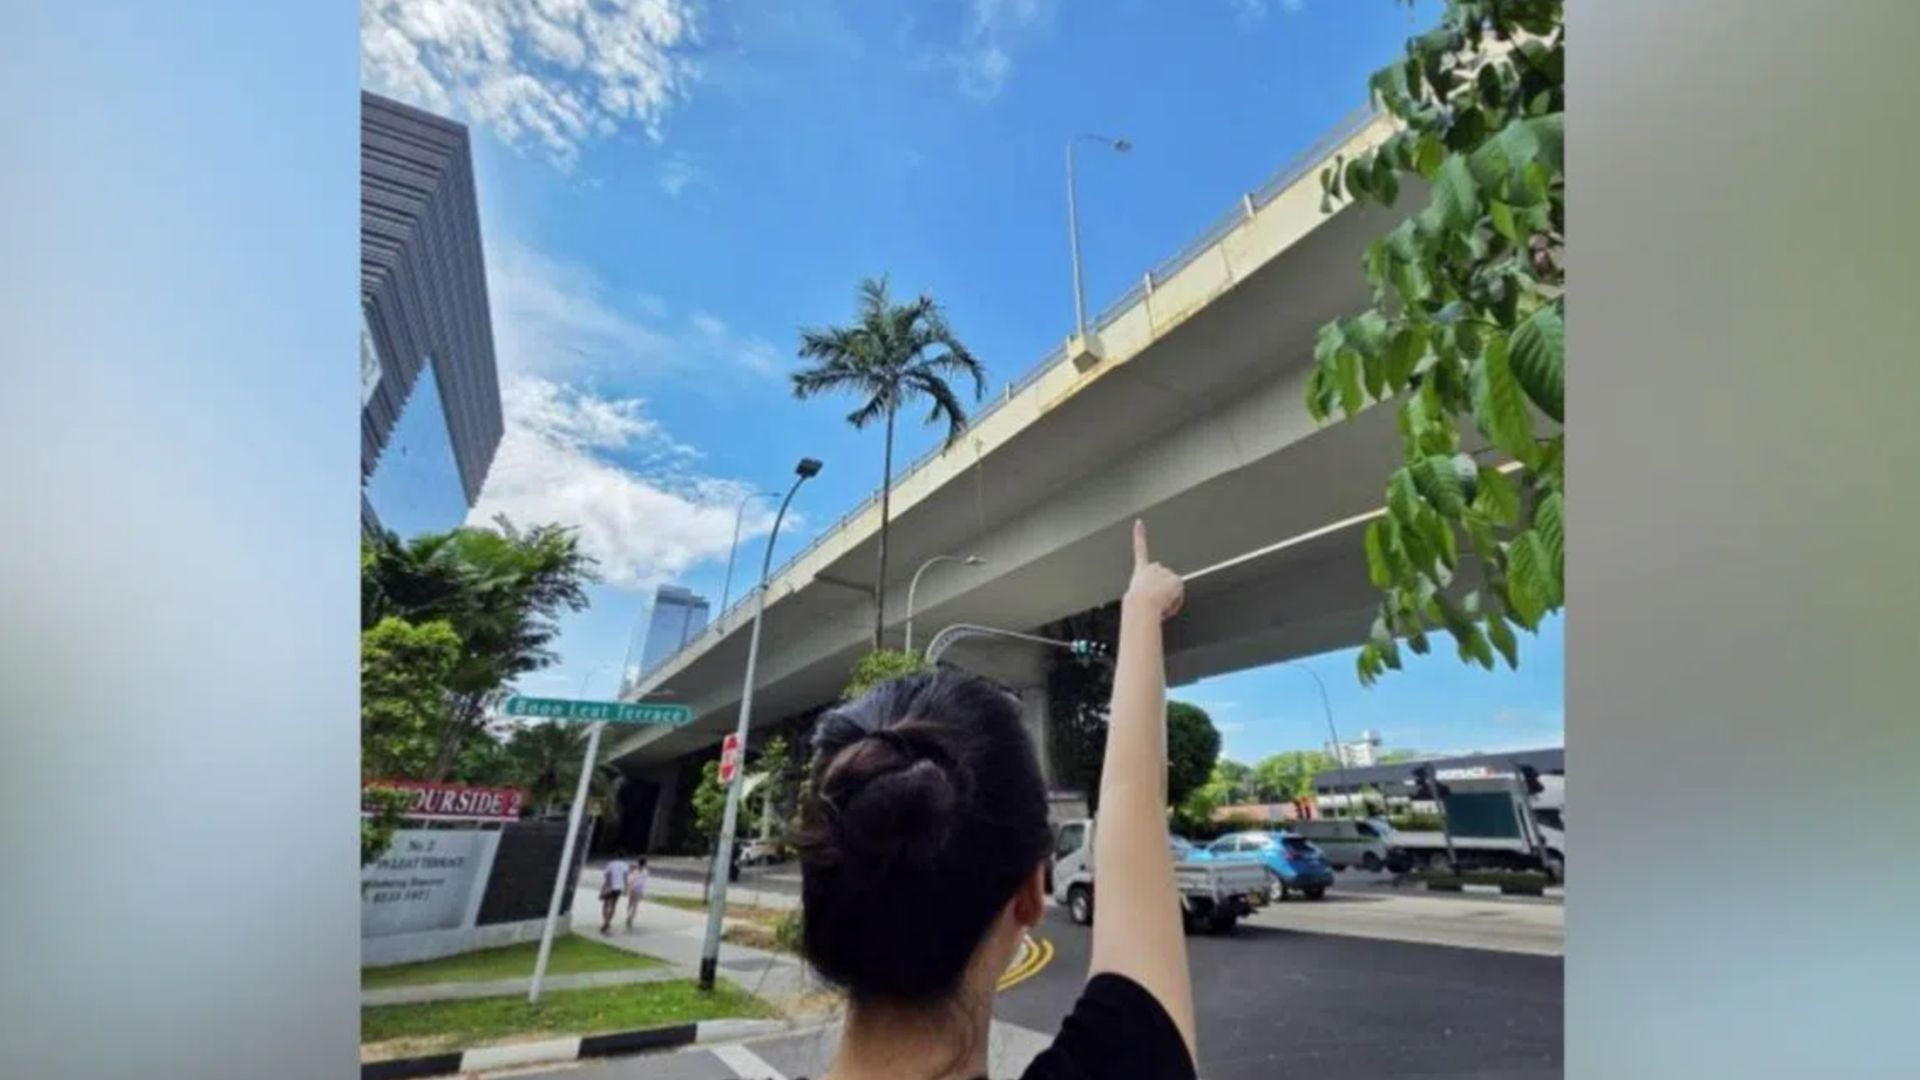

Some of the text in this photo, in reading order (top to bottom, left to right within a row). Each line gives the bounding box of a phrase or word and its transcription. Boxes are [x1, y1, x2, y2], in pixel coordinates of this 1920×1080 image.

[514, 699, 684, 722] Boon Leat Terrace
[403, 787, 523, 815] OURSIDE 2
